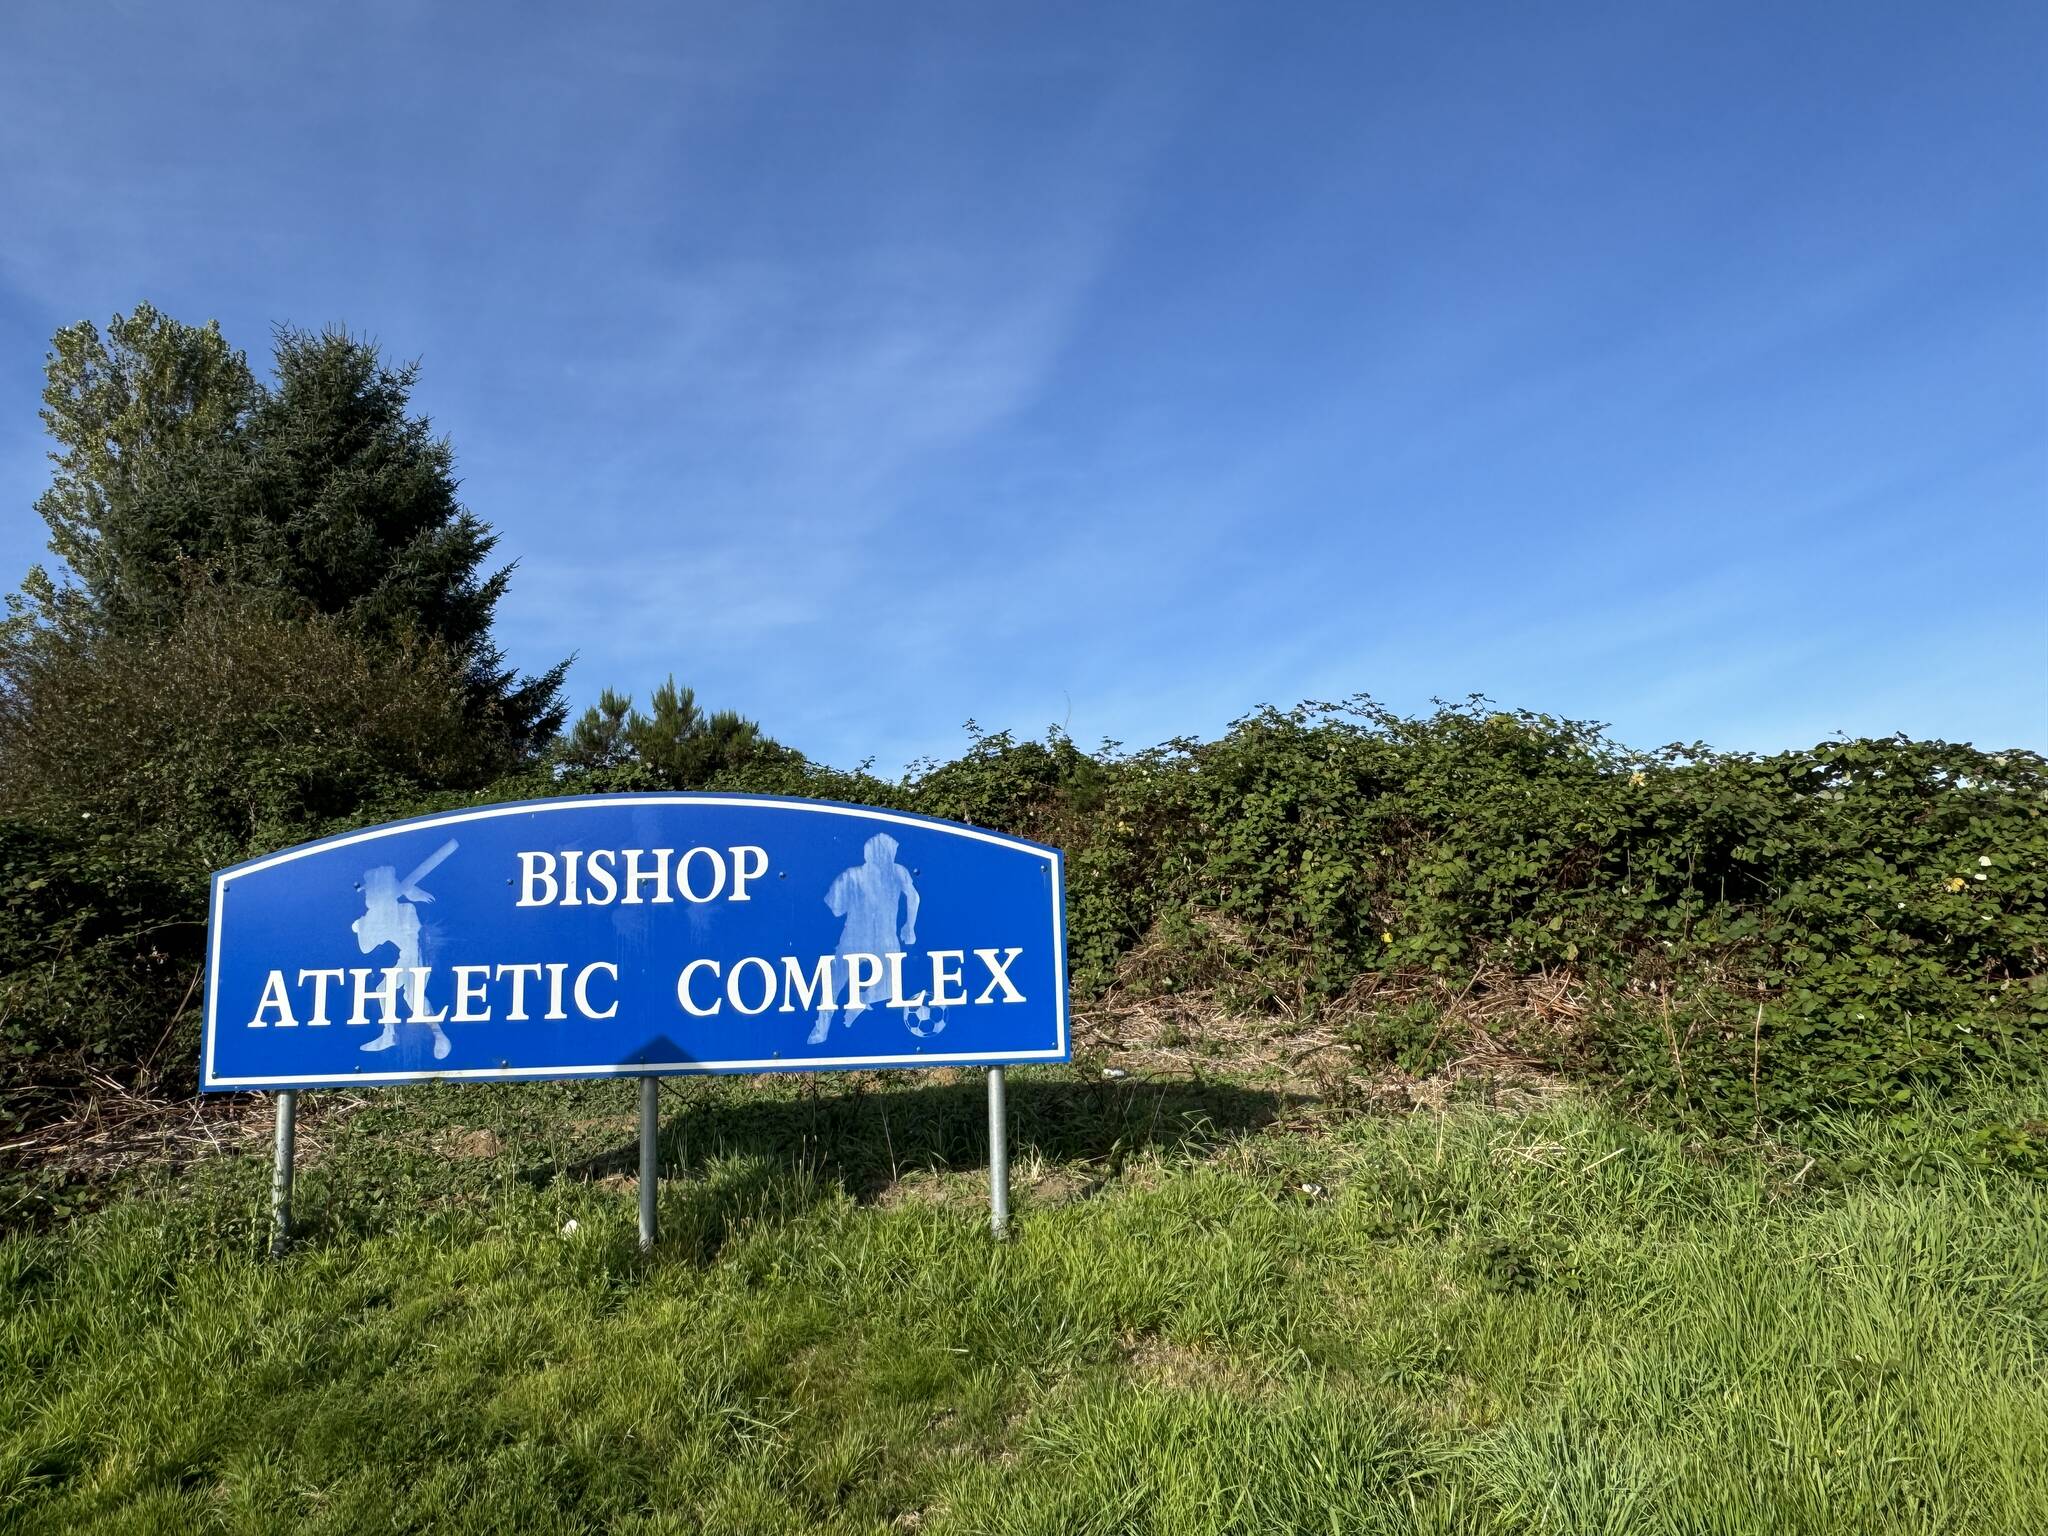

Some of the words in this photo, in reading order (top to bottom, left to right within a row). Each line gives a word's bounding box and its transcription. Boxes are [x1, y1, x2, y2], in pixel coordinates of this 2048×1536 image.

[515, 845, 769, 907] BISHOP
[247, 961, 619, 1028] ATHLETIC
[677, 947, 1027, 1017] COMPLEX
